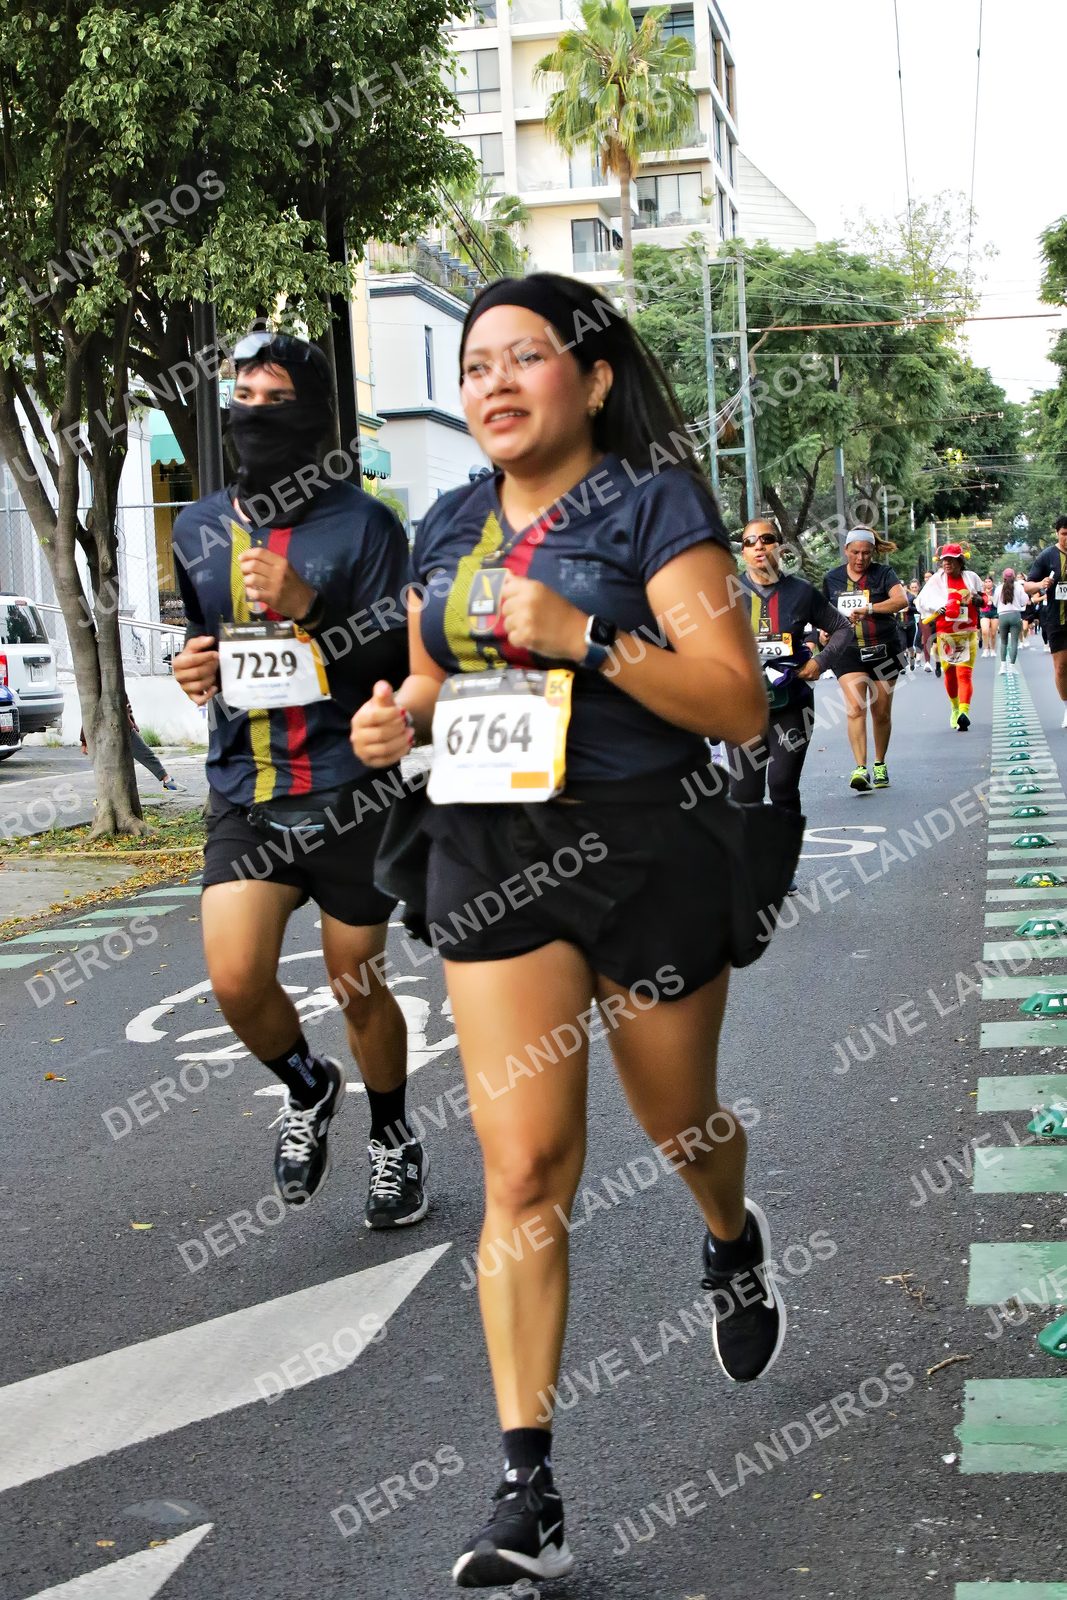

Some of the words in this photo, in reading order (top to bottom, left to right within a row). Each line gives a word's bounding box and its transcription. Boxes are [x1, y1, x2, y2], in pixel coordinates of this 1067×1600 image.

[841, 598, 863, 608] 4532
[232, 650, 298, 680] 7229
[447, 711, 533, 756] 6764
